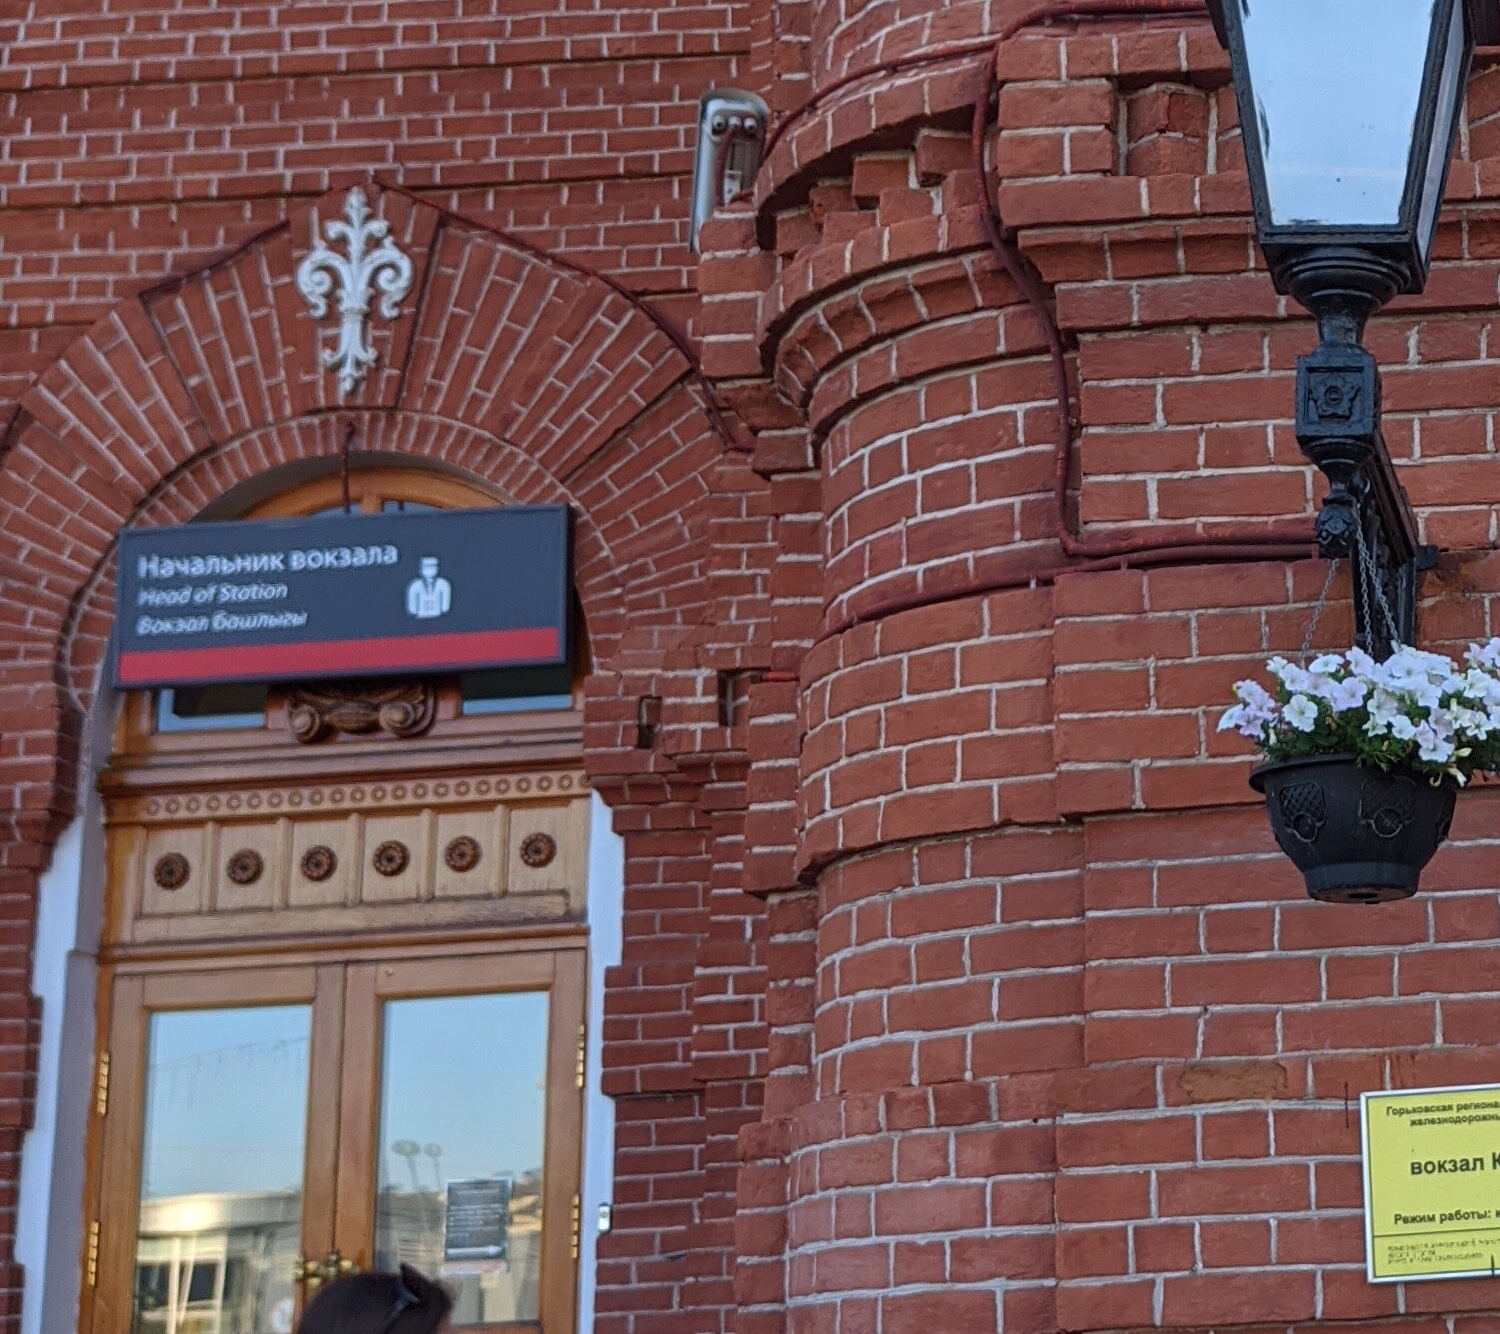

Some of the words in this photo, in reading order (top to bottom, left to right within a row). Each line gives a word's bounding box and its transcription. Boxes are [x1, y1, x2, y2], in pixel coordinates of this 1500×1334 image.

[137, 553, 285, 578] Начальник
[290, 545, 399, 571] вокзала
[137, 586, 193, 606] Head
[193, 582, 218, 604] of
[219, 581, 288, 604] Station
[1386, 1103, 1454, 1117] Горьковская
[1410, 1157, 1485, 1176] вокзал
[1394, 1213, 1436, 1225] Режим
[1439, 1209, 1492, 1225] работы:
